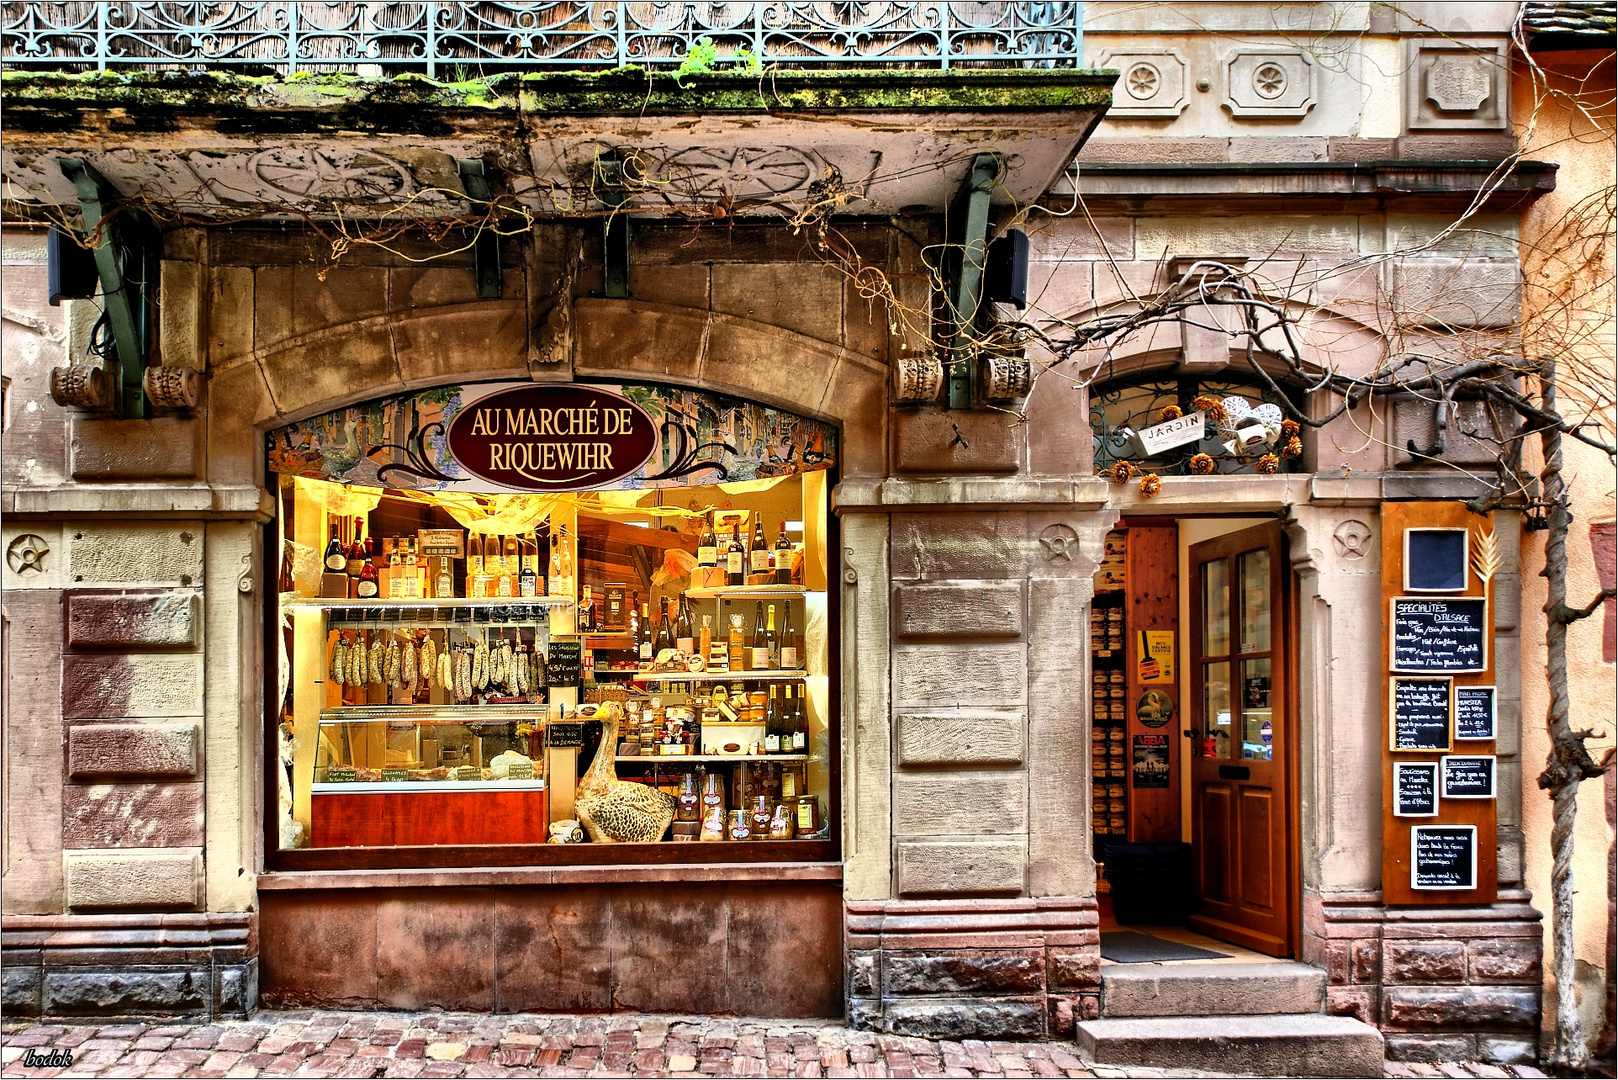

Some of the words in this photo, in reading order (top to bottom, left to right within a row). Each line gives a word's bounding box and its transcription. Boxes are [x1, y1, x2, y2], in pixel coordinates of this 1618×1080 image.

[470, 408, 501, 436] AU
[505, 400, 599, 436] MARCHÉ
[603, 408, 633, 435] DE
[1148, 415, 1199, 439] JARDIN
[489, 443, 614, 483] RIQUEWIHR
[1434, 613, 1471, 622] D'ALSACE
[1138, 736, 1165, 744] ABBA
